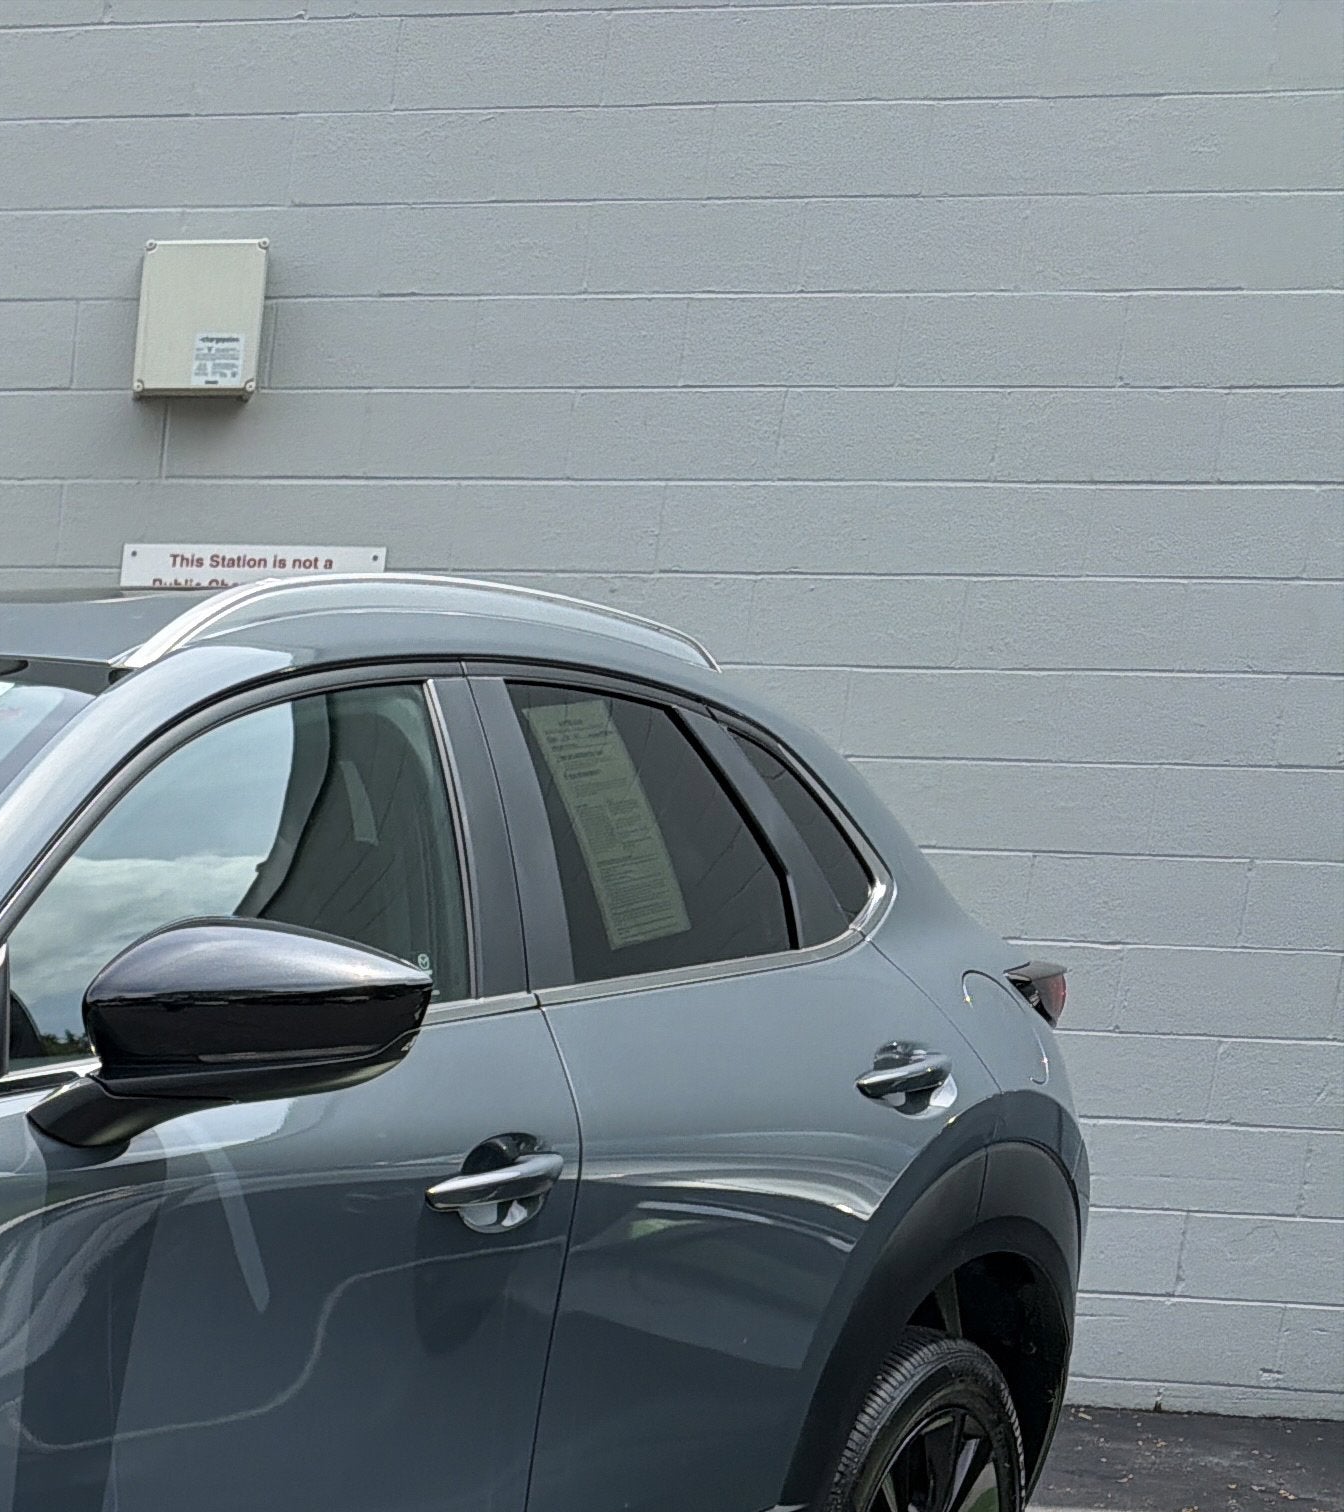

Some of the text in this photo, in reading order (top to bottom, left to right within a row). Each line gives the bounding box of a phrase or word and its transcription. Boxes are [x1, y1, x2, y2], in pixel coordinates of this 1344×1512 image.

[169, 553, 333, 570] This Station is not a
